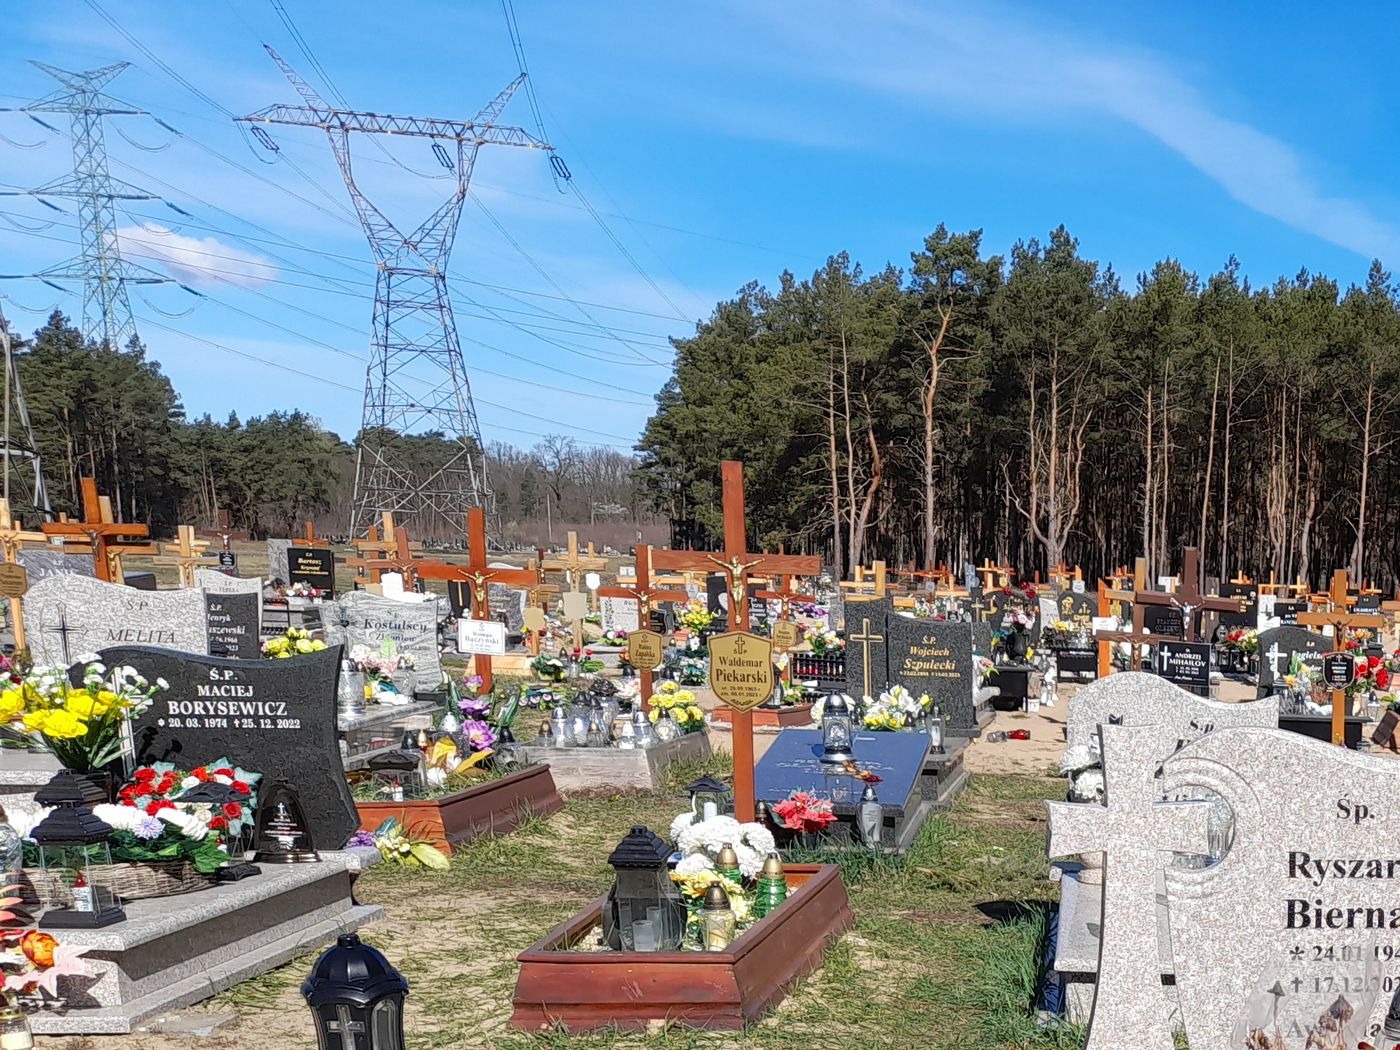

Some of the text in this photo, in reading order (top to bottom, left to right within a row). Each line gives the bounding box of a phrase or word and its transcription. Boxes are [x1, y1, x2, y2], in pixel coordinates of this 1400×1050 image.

[106, 628, 175, 643] MELITA
[910, 645, 950, 657] Wojciech
[718, 655, 764, 668] Waldemar
[903, 658, 957, 671] Szpulecki
[209, 667, 238, 681] Ś.P.
[715, 668, 768, 684] Piekarski
[197, 684, 254, 697] MACIEJ
[167, 700, 288, 716] BORYSEWICZ
[204, 717, 228, 728] 1974
[276, 718, 301, 729] 2022
